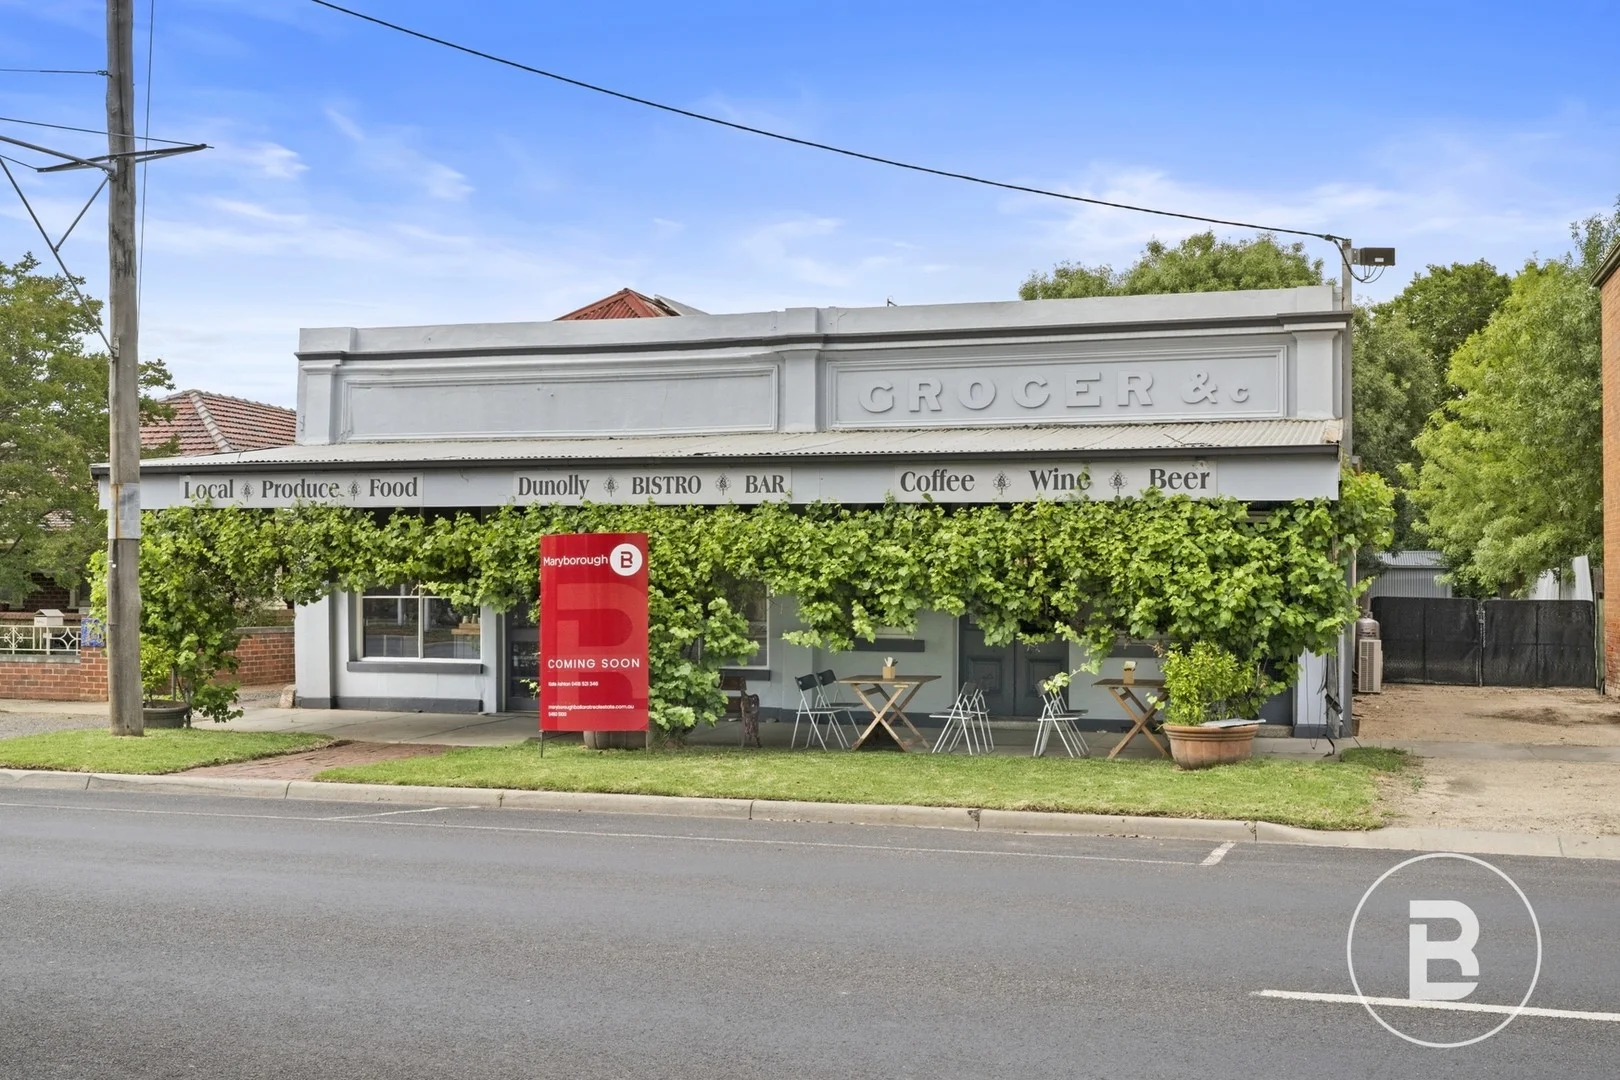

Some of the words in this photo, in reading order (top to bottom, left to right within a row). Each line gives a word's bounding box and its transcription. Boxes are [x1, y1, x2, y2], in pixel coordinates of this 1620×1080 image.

[858, 370, 1155, 414] GROCER
[183, 478, 234, 500] Local
[261, 477, 340, 499] Produce
[369, 476, 418, 498] Food
[518, 474, 590, 498] Dunolly
[631, 474, 702, 495] BISTRO
[745, 474, 786, 494] BAR
[899, 468, 976, 493] Coffee
[1029, 467, 1092, 491] Wine
[1149, 467, 1211, 490] Beer
[543, 555, 609, 568] Maryborough
[621, 552, 633, 568] B
[548, 659, 596, 669] COMING
[602, 658, 640, 668] SOON
